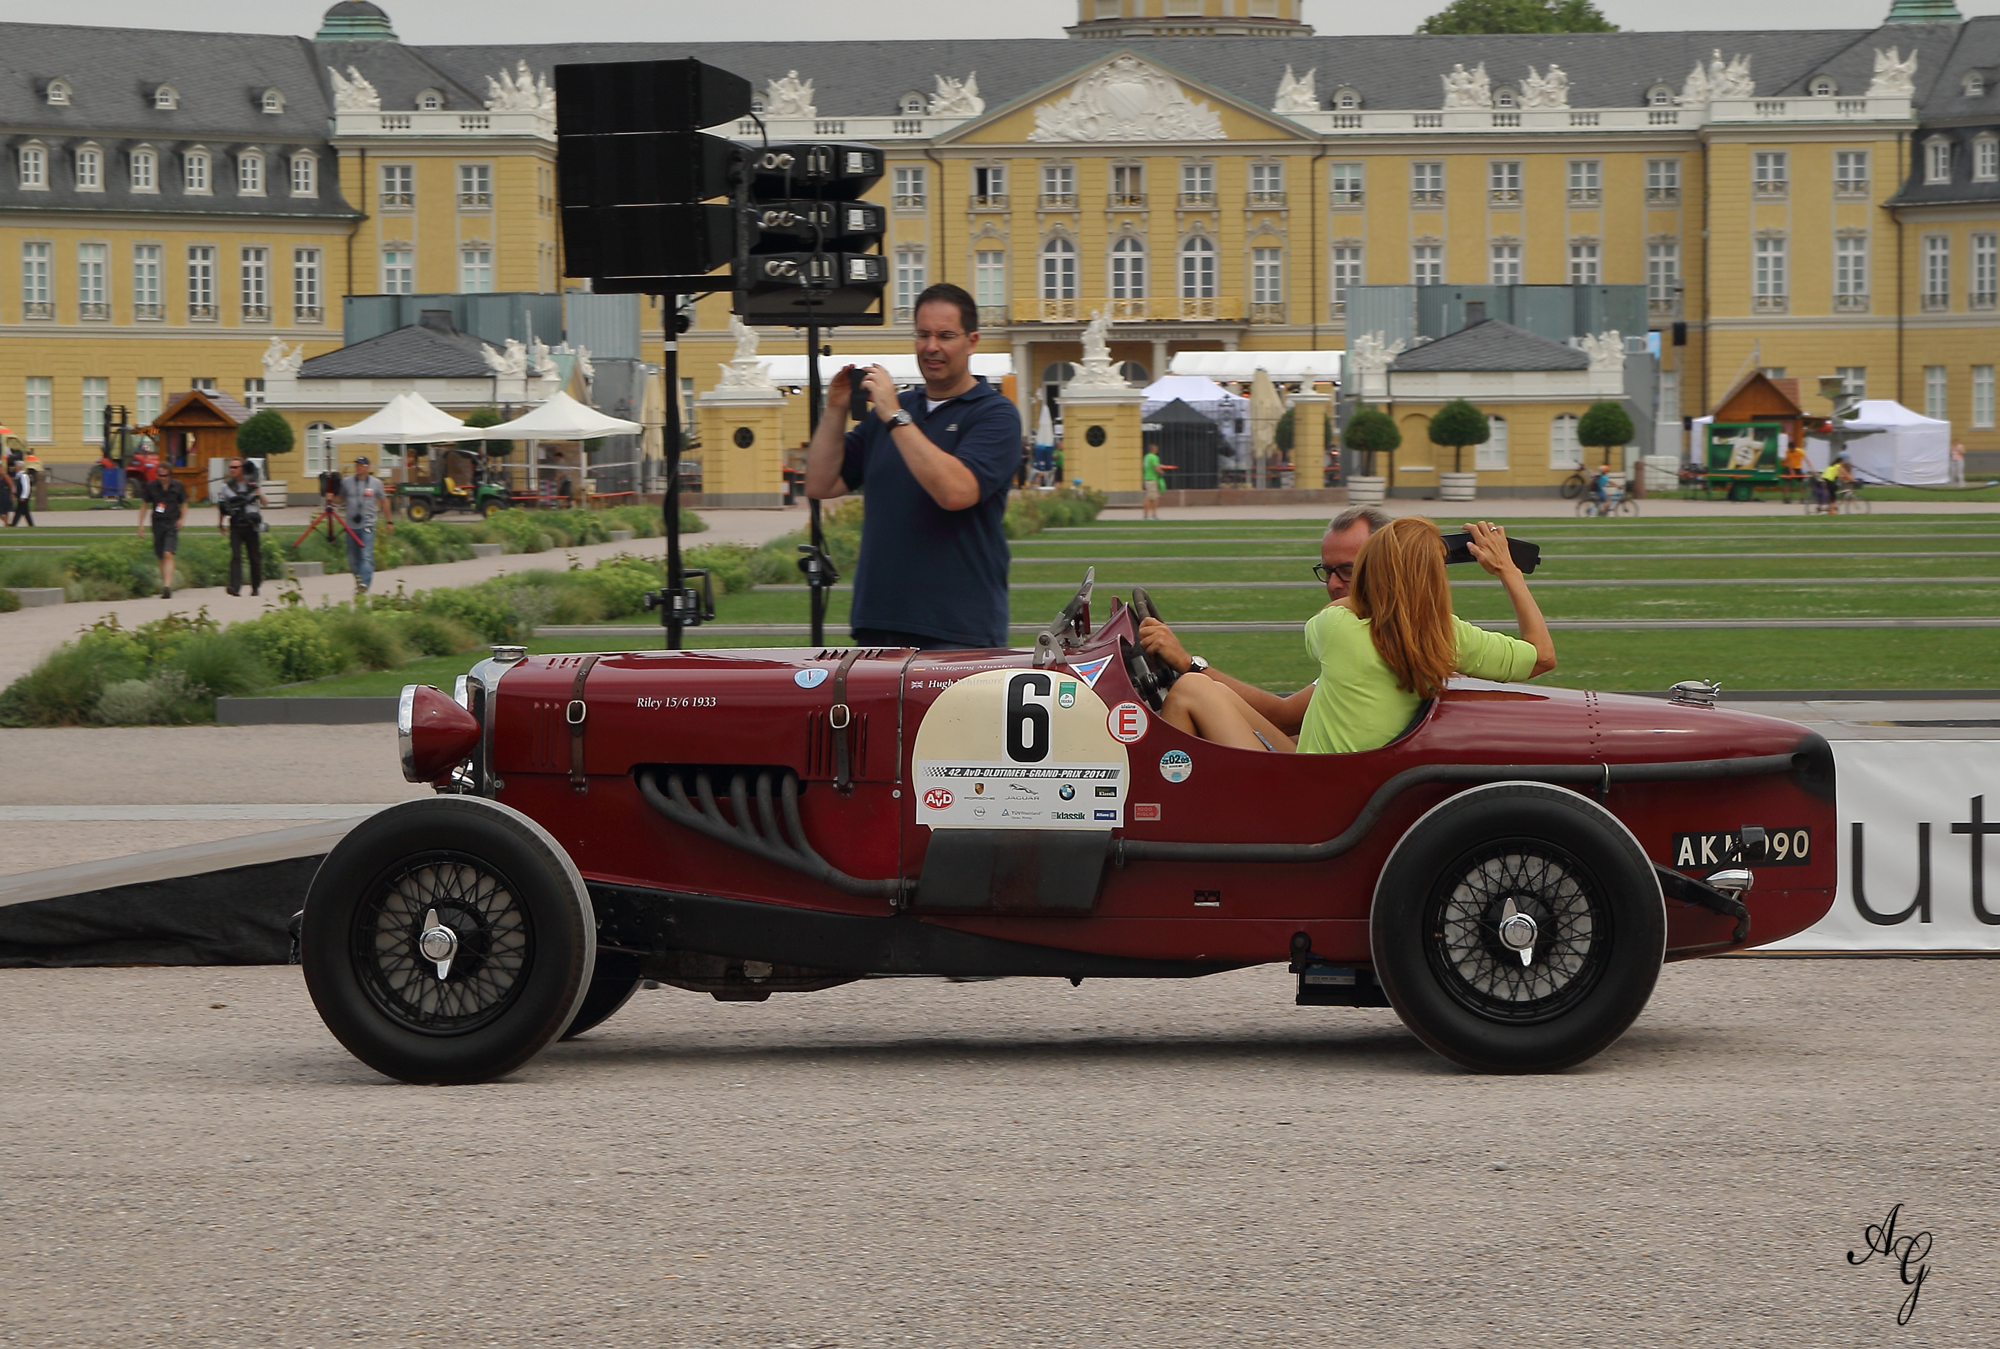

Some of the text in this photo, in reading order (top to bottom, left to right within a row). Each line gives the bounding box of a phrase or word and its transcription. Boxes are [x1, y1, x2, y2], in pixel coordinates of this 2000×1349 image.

[928, 679, 954, 690] Hugh
[637, 696, 716, 710] Riley 15/6 1933
[1007, 674, 1050, 762] 6
[1119, 709, 1137, 734] E
[948, 768, 962, 777] 42.
[1083, 770, 1107, 779] 2014
[1056, 811, 1086, 820] klassik
[1762, 829, 1810, 860] 90
